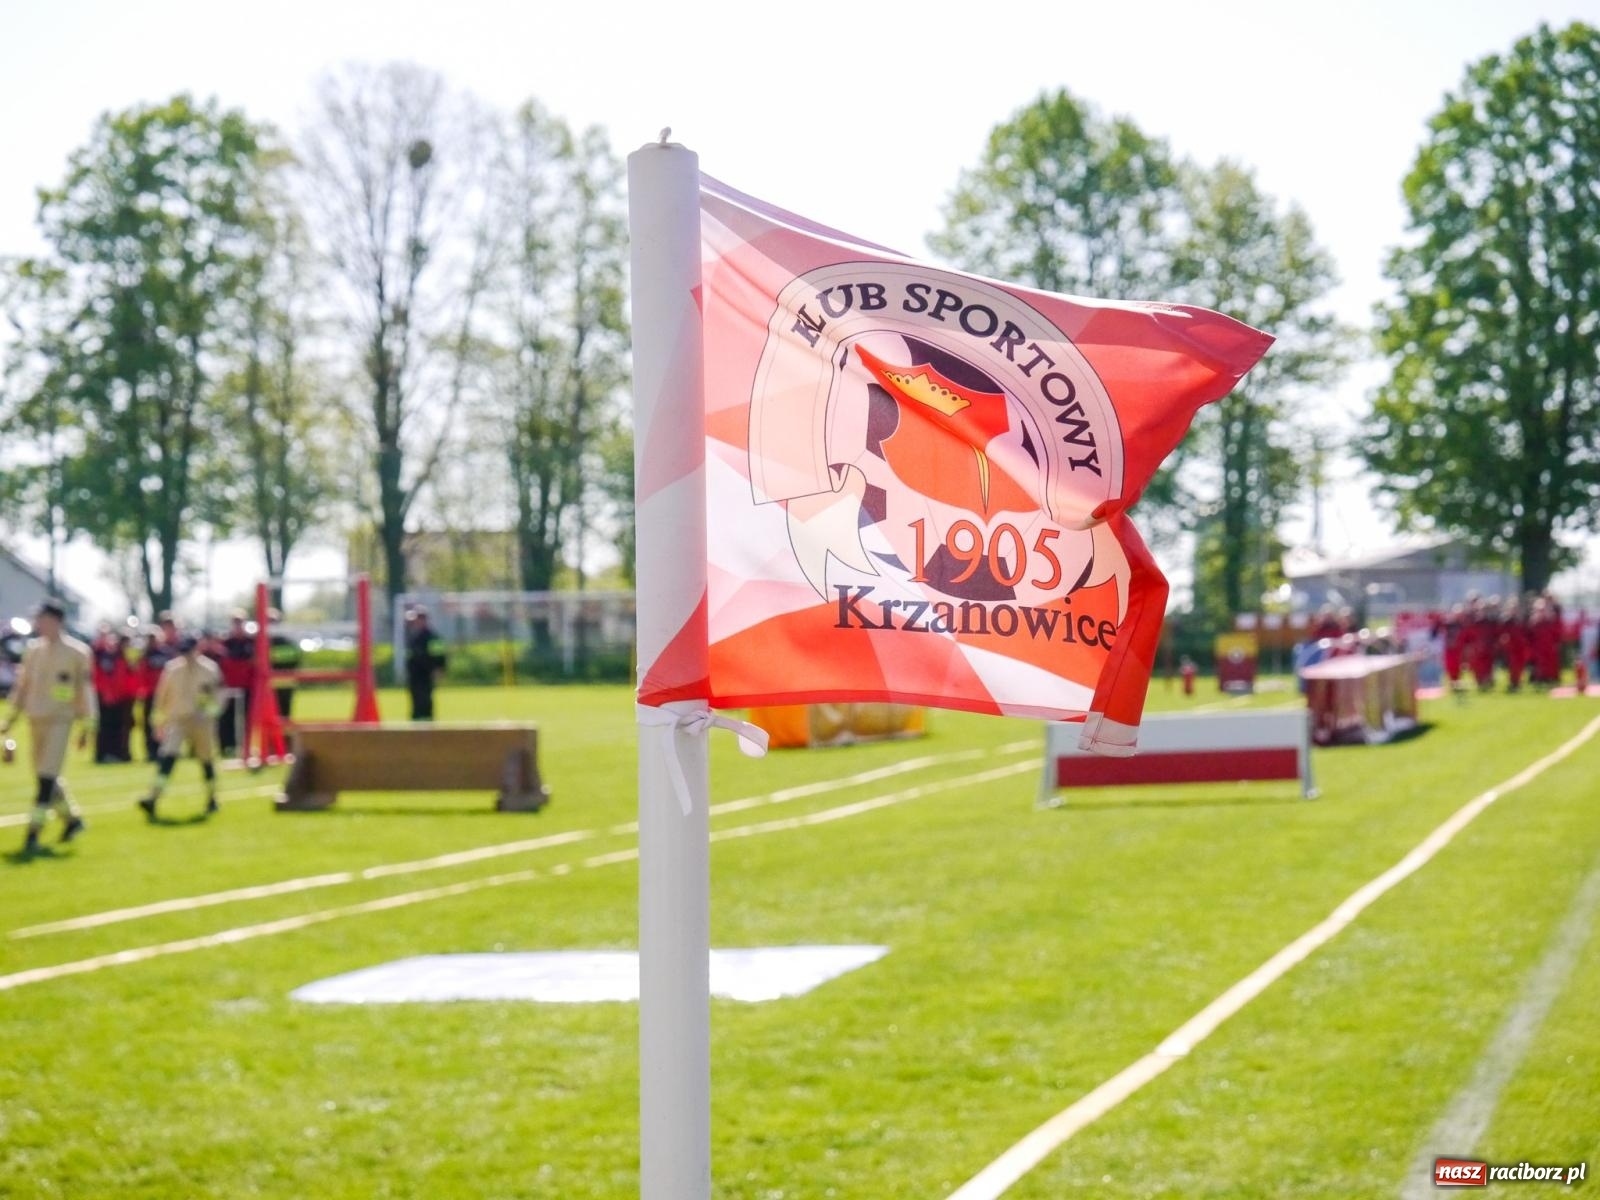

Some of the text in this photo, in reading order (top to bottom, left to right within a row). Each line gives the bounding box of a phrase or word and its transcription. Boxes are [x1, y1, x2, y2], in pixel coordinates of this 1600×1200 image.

[791, 282, 1103, 478] KLUB SPORTOWY
[907, 517, 1063, 591] 1905
[833, 584, 1117, 651] Krzanowice
